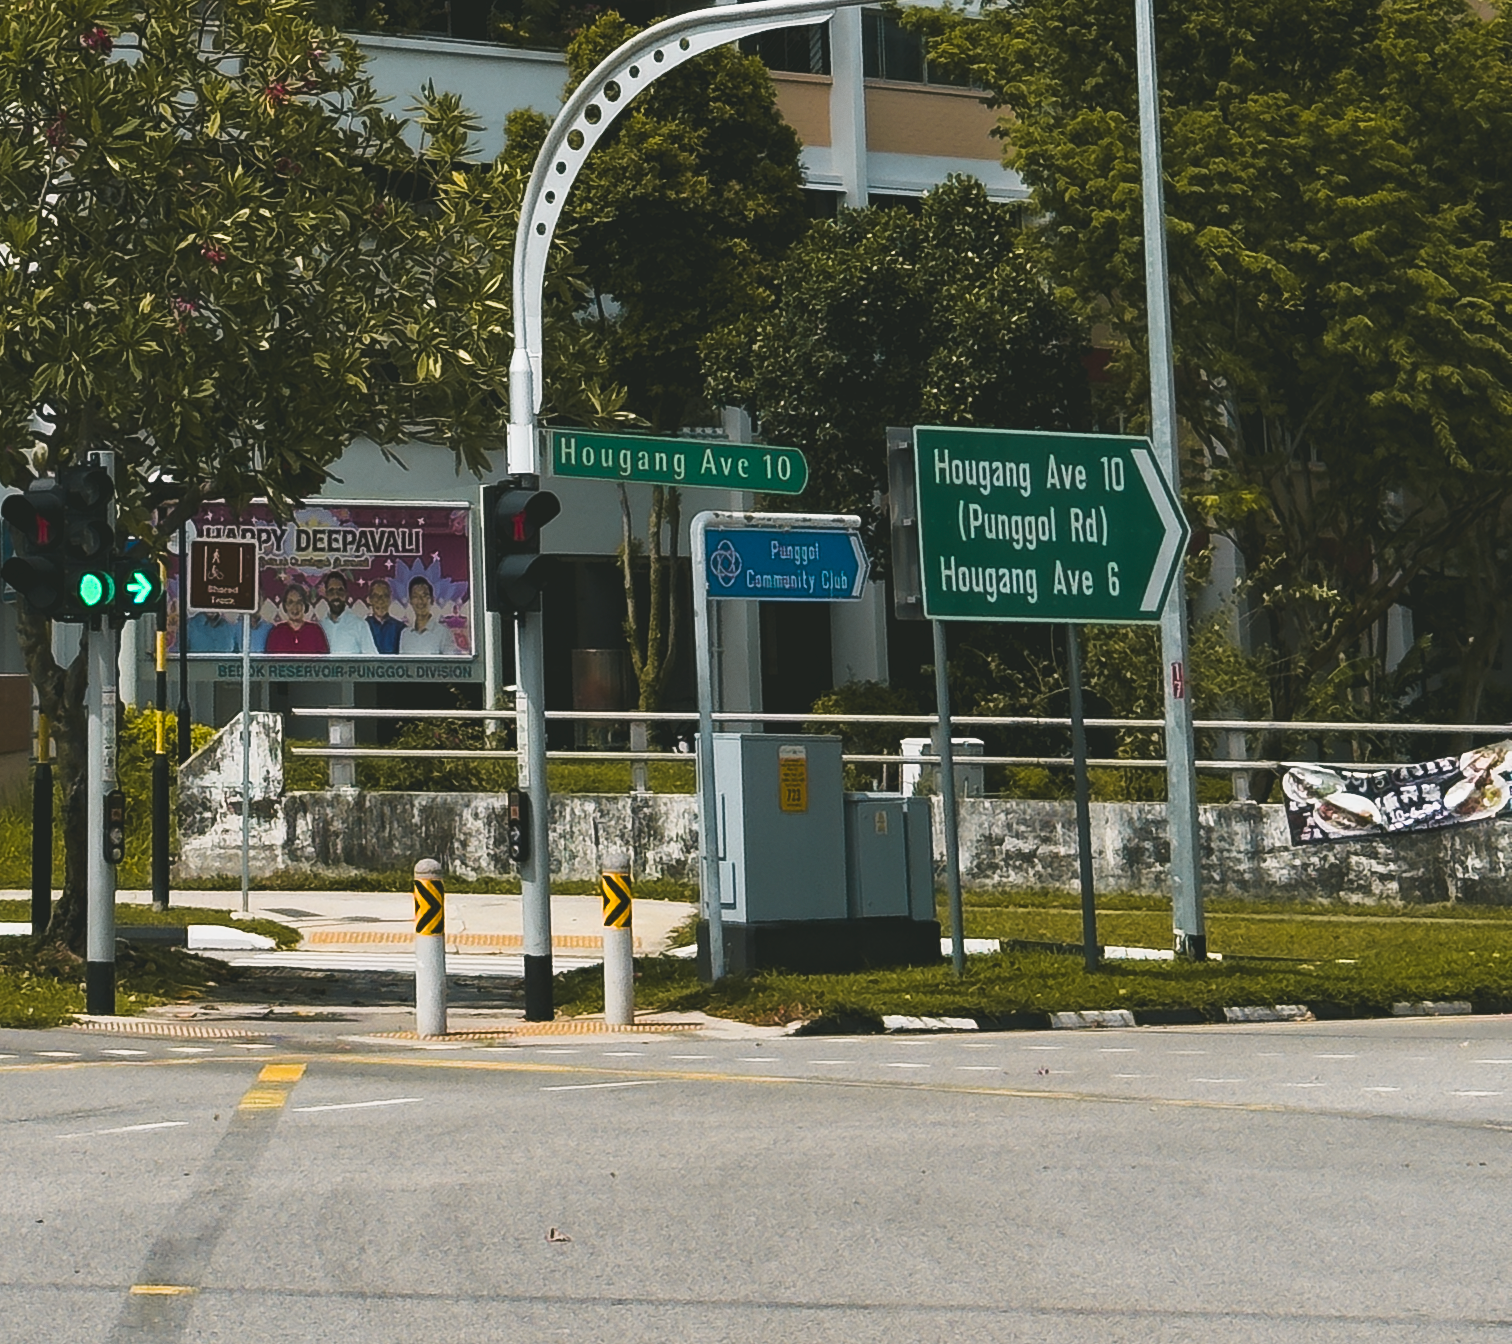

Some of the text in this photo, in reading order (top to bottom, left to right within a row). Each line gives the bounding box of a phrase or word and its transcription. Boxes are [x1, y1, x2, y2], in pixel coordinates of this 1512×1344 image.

[560, 437, 791, 480] Hougang Ave 10
[934, 448, 1125, 497] Hougang Ave 10
[295, 527, 422, 555] DEEPAVALI
[958, 500, 1108, 550] (Punggol Rd)
[770, 540, 820, 565] Punggol
[746, 569, 848, 593] Community Club
[940, 555, 1120, 603] Hougang Ave 6
[416, 664, 472, 679] DIVISION
